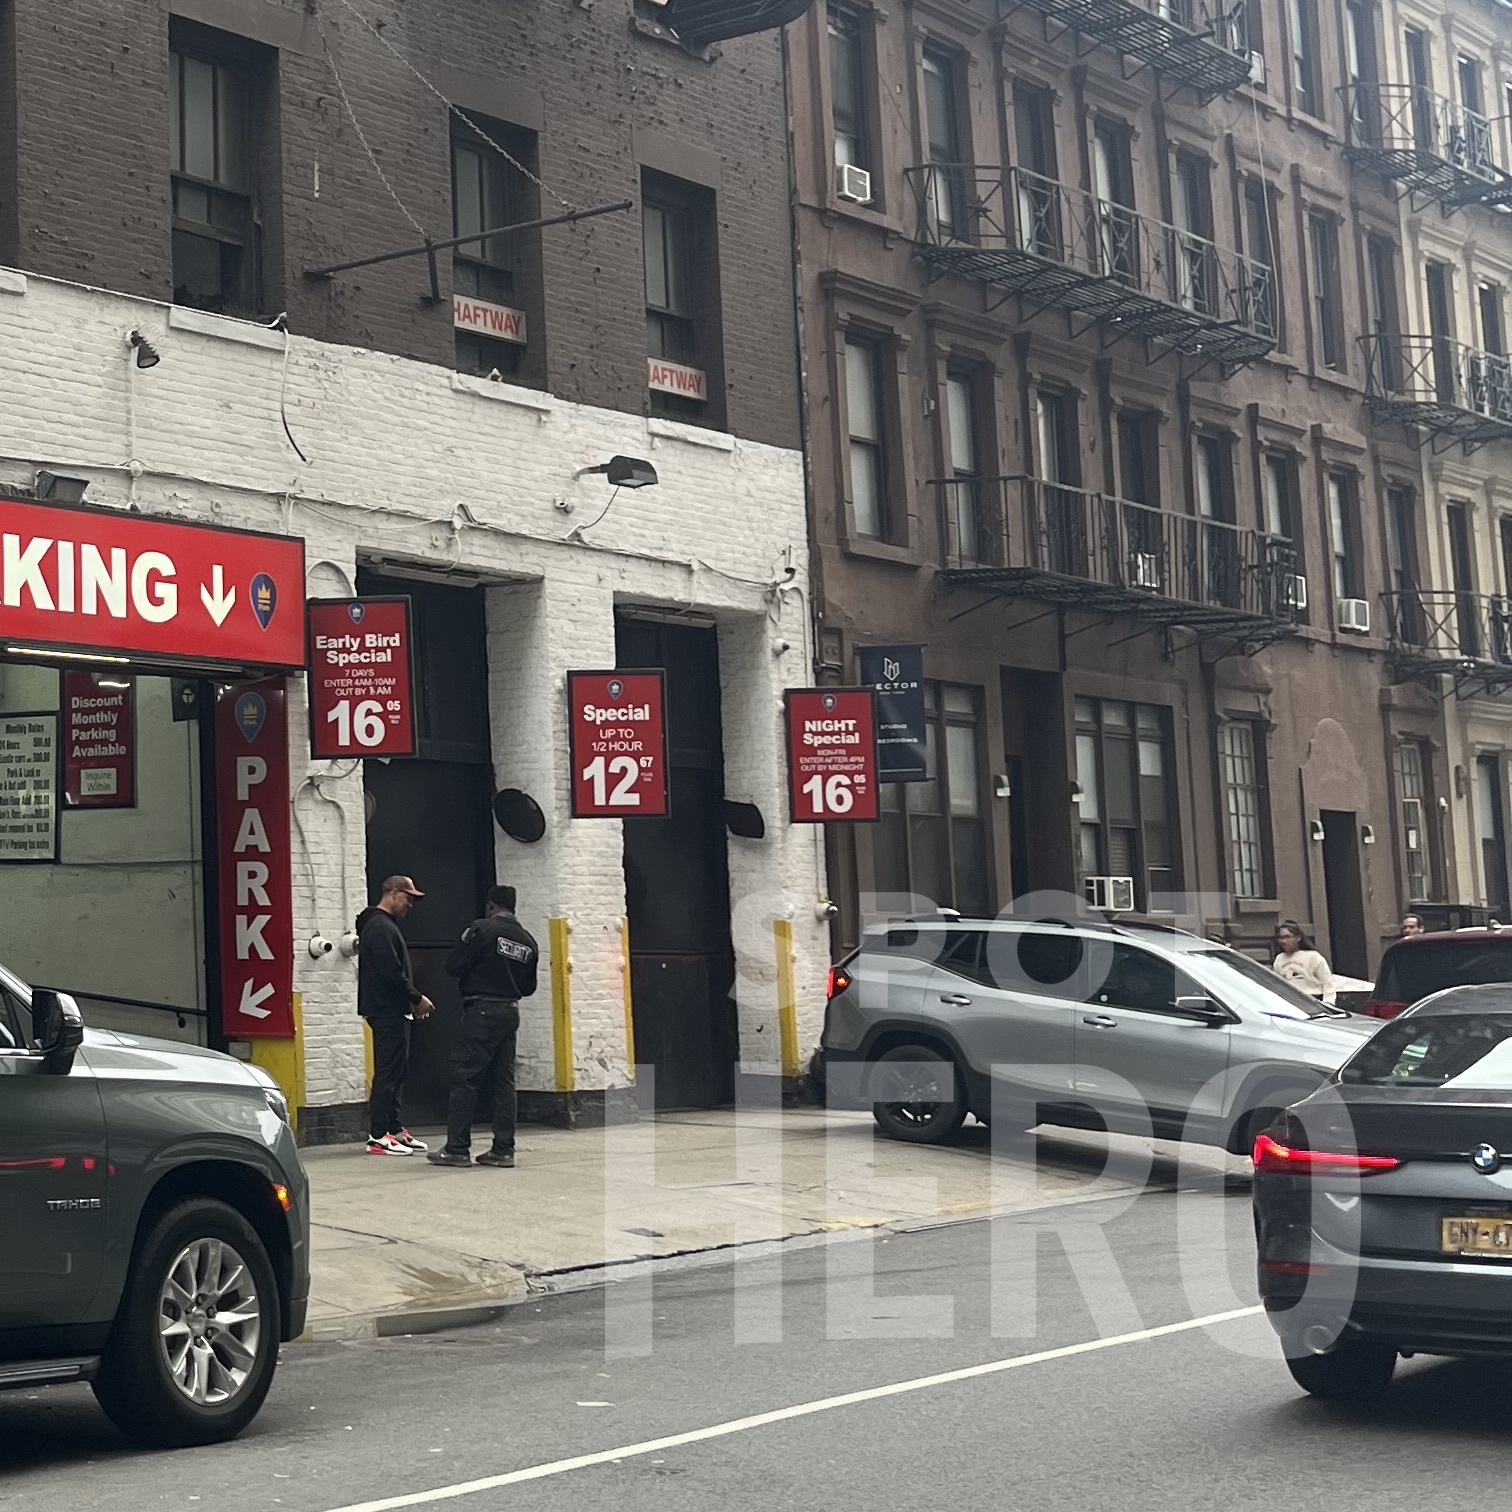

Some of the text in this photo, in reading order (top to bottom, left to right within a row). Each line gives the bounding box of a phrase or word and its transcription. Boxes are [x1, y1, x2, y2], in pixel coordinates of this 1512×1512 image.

[315, 633, 401, 651] Early Bird
[326, 649, 392, 667] Special
[344, 669, 375, 677] 7 DAYS
[324, 679, 353, 687] ENTER
[868, 682, 918, 691] ECTOR
[335, 689, 354, 697] OUT
[355, 688, 366, 696] BY
[71, 694, 123, 709] Discount
[71, 710, 118, 726] Monthly
[583, 704, 650, 725] Special
[327, 699, 401, 747] 16 05
[804, 720, 857, 732] NIGHT
[71, 728, 117, 741] Parking
[599, 728, 635, 739] UP TO
[802, 732, 860, 747] Special
[72, 743, 127, 758] Available
[591, 741, 643, 752] 1/2 HOUR
[828, 763, 865, 771] MIDNIGHT
[582, 755, 654, 806] 12 67
[802, 774, 866, 814] 16 05
[232, 755, 275, 962] PARK
[46, 1198, 101, 1211] TAHOE
